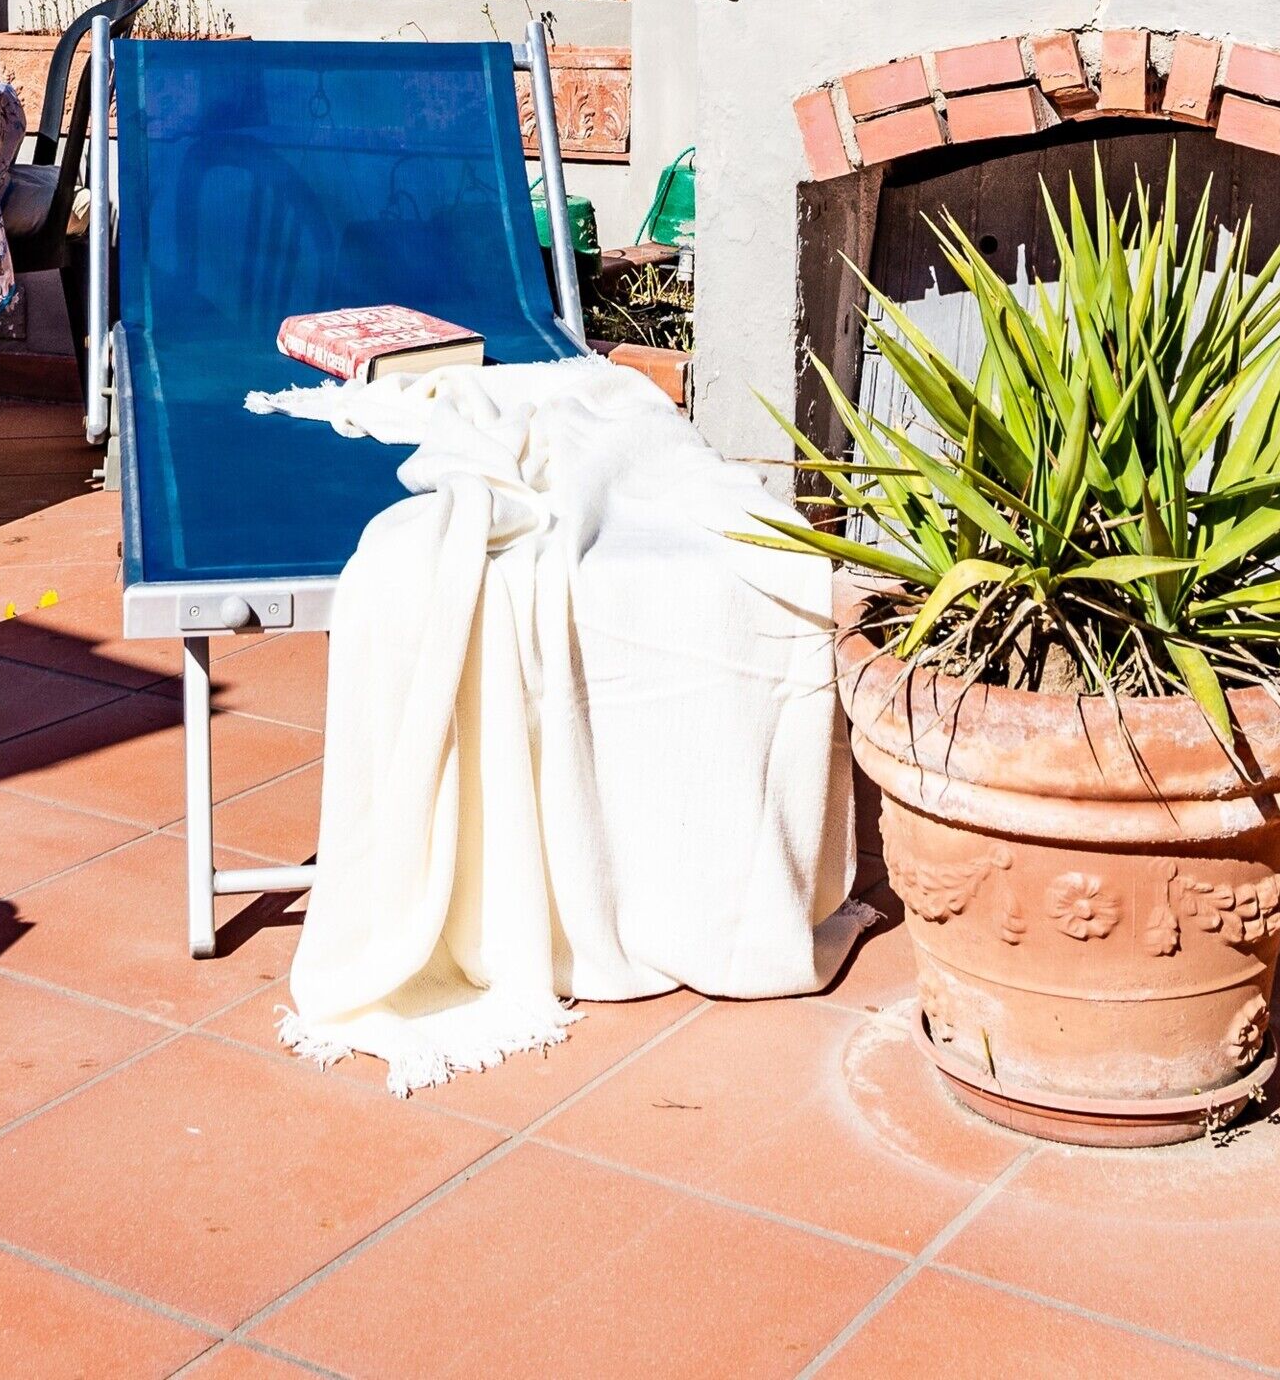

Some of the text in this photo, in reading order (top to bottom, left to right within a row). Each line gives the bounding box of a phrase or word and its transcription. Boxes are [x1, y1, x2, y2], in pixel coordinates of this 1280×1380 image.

[299, 307, 411, 329] FOURTH
[322, 315, 423, 339] OF JULY
[346, 329, 438, 349] CREEK
